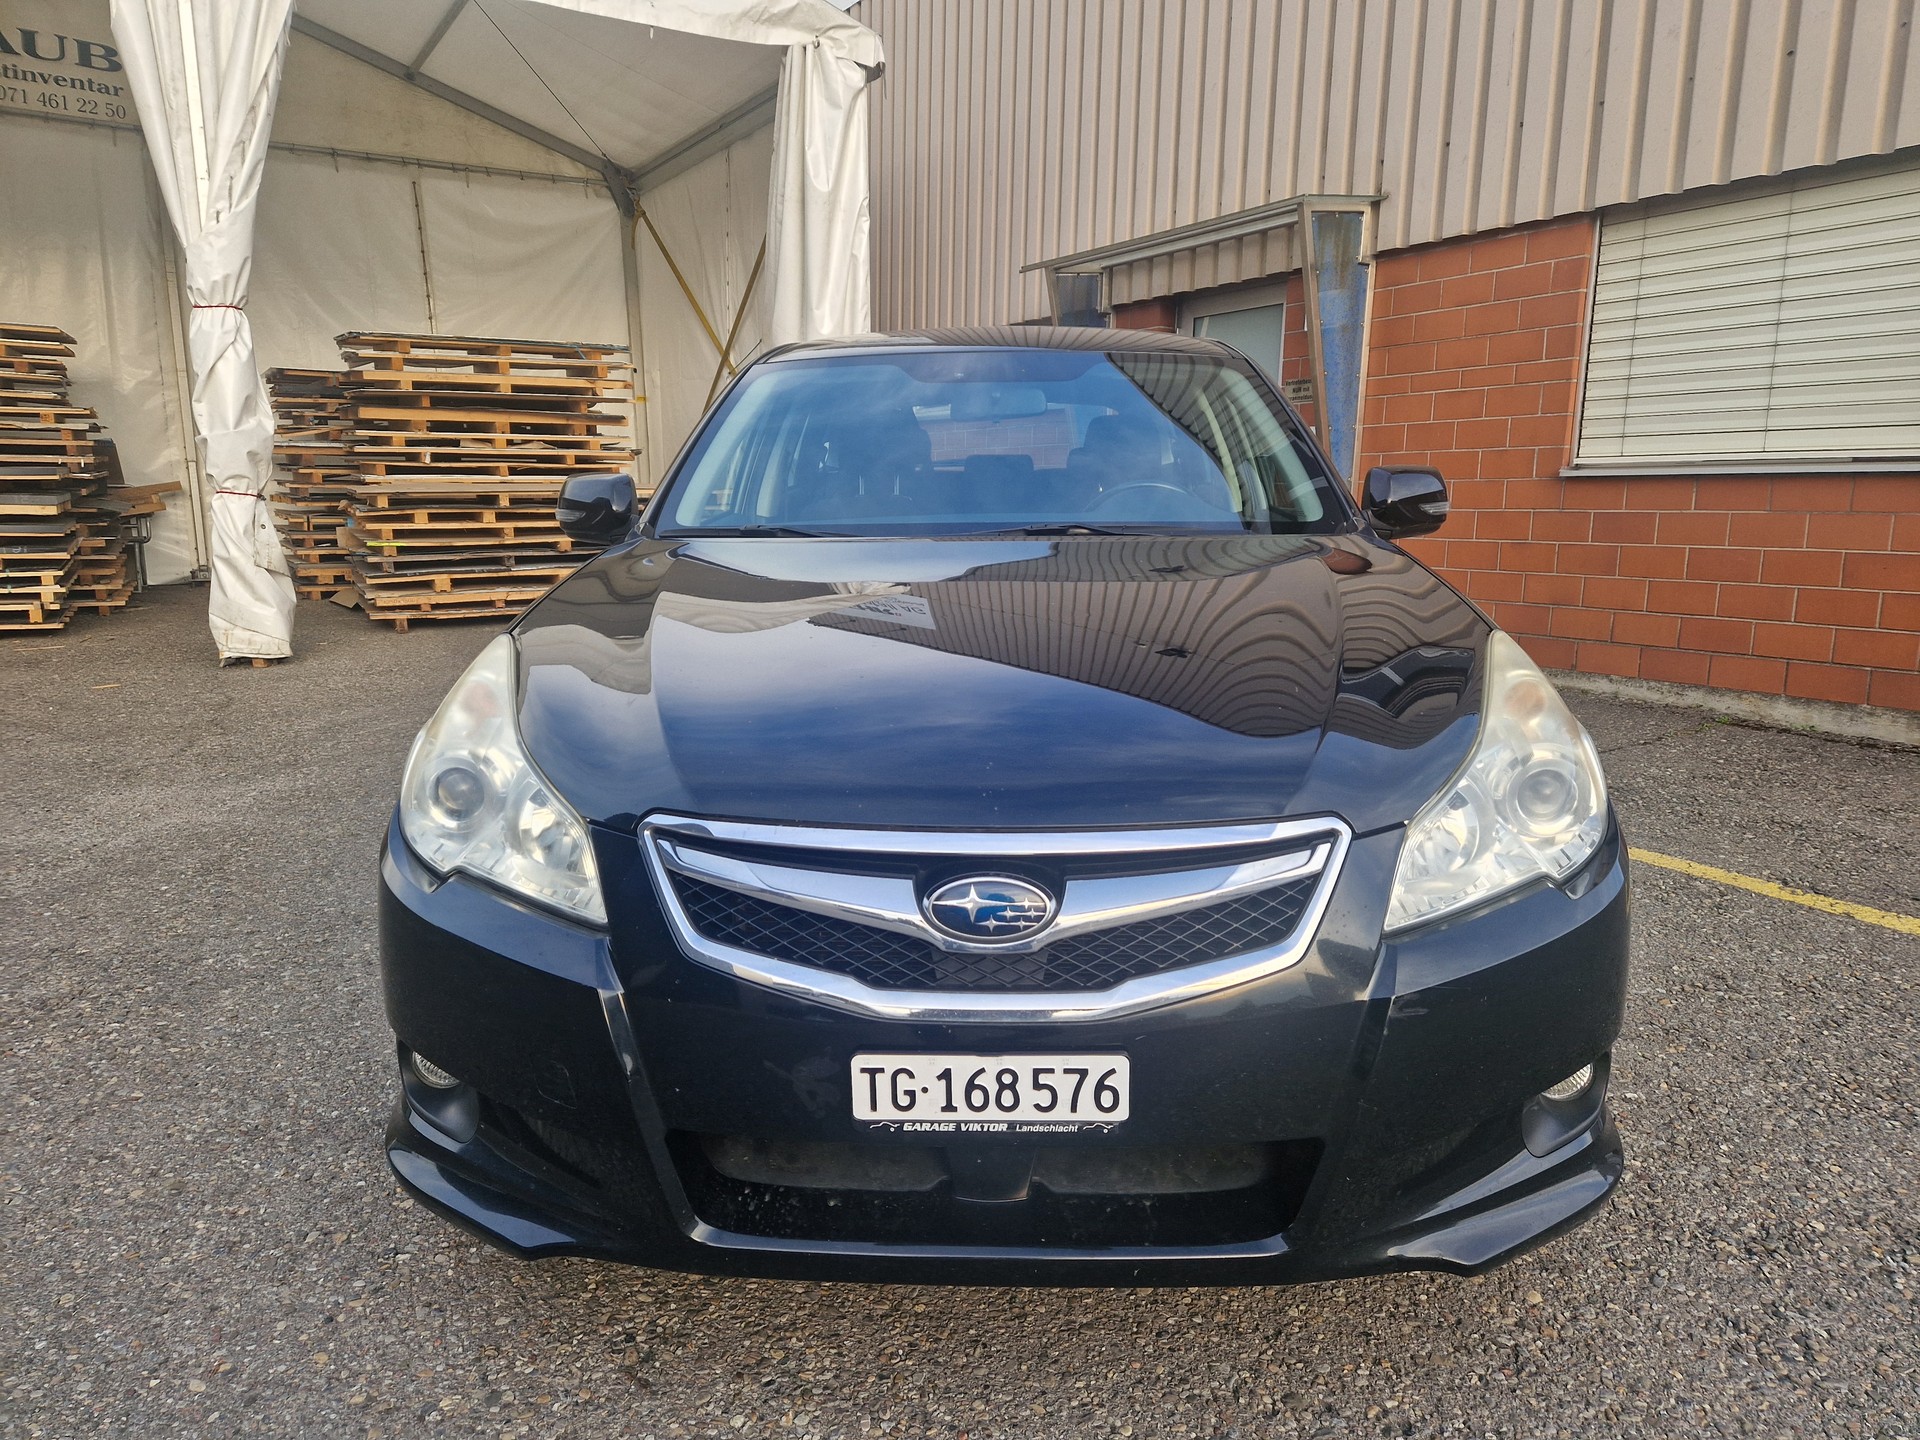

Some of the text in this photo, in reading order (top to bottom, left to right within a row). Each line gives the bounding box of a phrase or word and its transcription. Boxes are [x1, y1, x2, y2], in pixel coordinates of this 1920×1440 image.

[1, 63, 124, 97] tinventar
[37, 92, 69, 111] 461
[76, 97, 98, 115] 22
[105, 103, 126, 119] 50
[903, 1122, 1079, 1133] GARAGE VIKTOR Landschlacht
